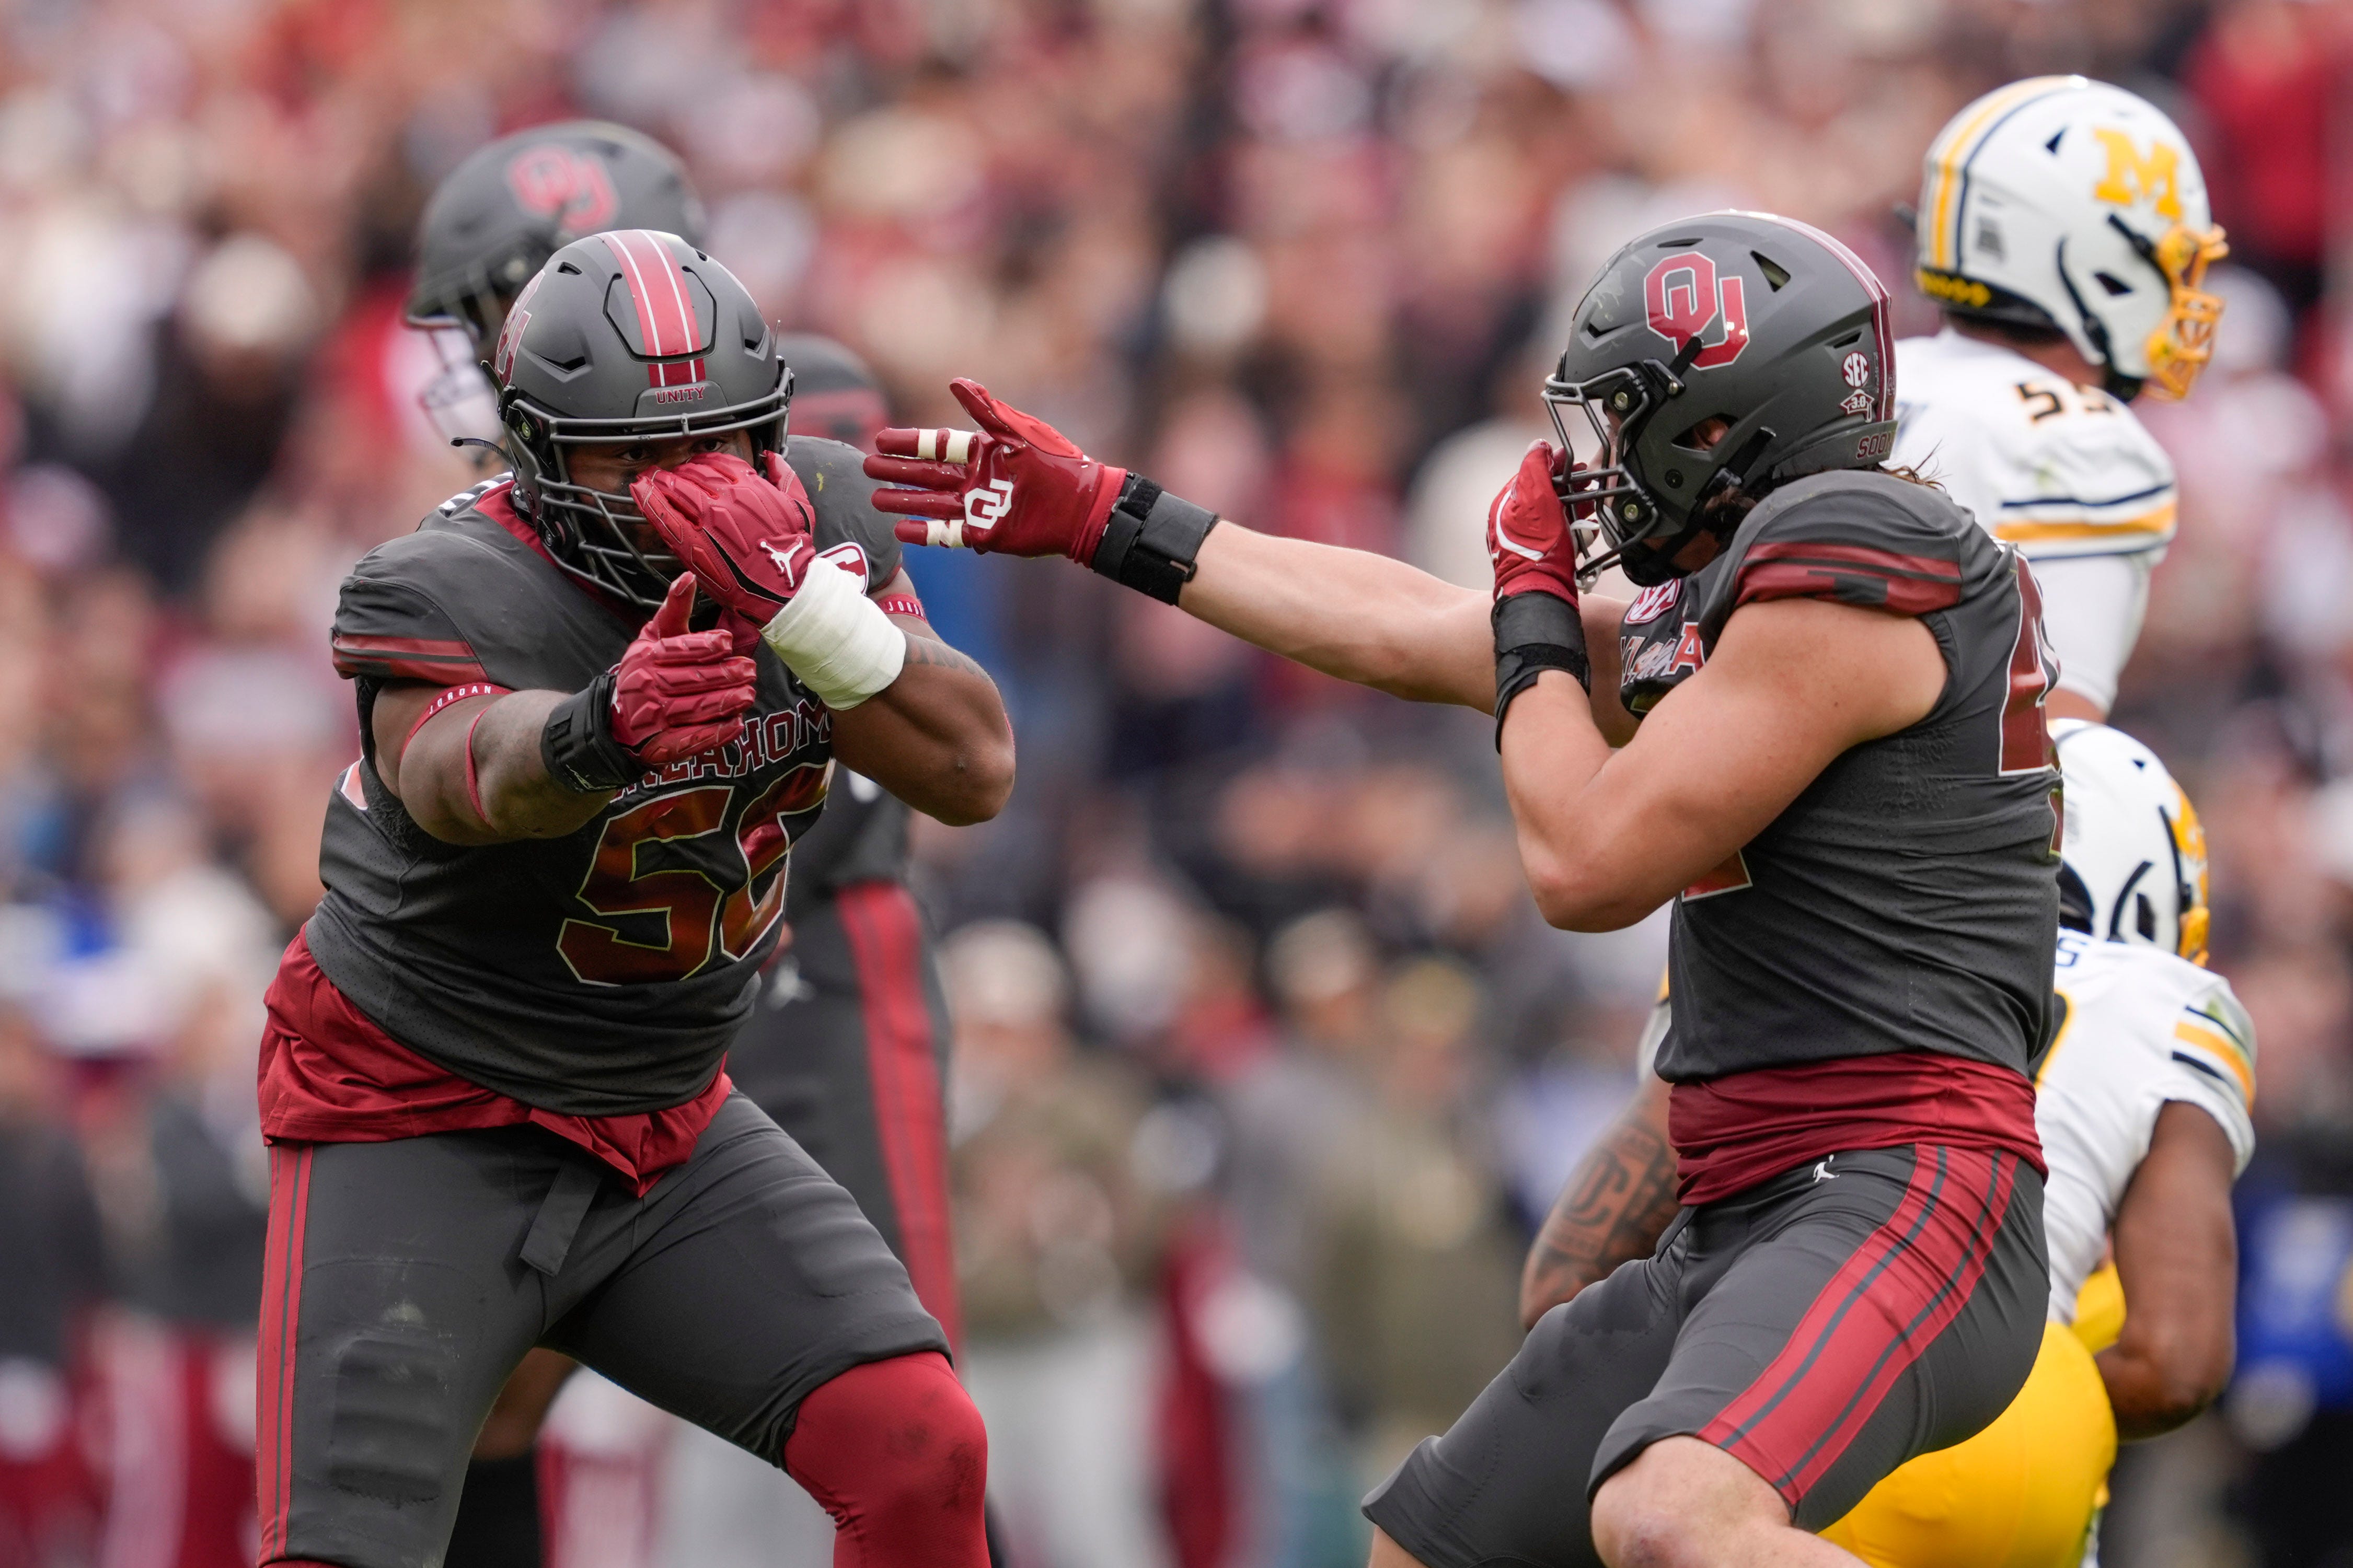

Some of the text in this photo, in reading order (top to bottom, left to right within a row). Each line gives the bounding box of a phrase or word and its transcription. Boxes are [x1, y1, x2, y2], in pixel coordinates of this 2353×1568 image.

[2093, 127, 2183, 222] M
[1644, 251, 1749, 370] OU
[1843, 352, 1869, 388] SEC
[655, 386, 705, 405] UNITY
[1851, 395, 1866, 410] 3.0
[964, 478, 1014, 530] OU
[429, 685, 491, 715] JORDAN
